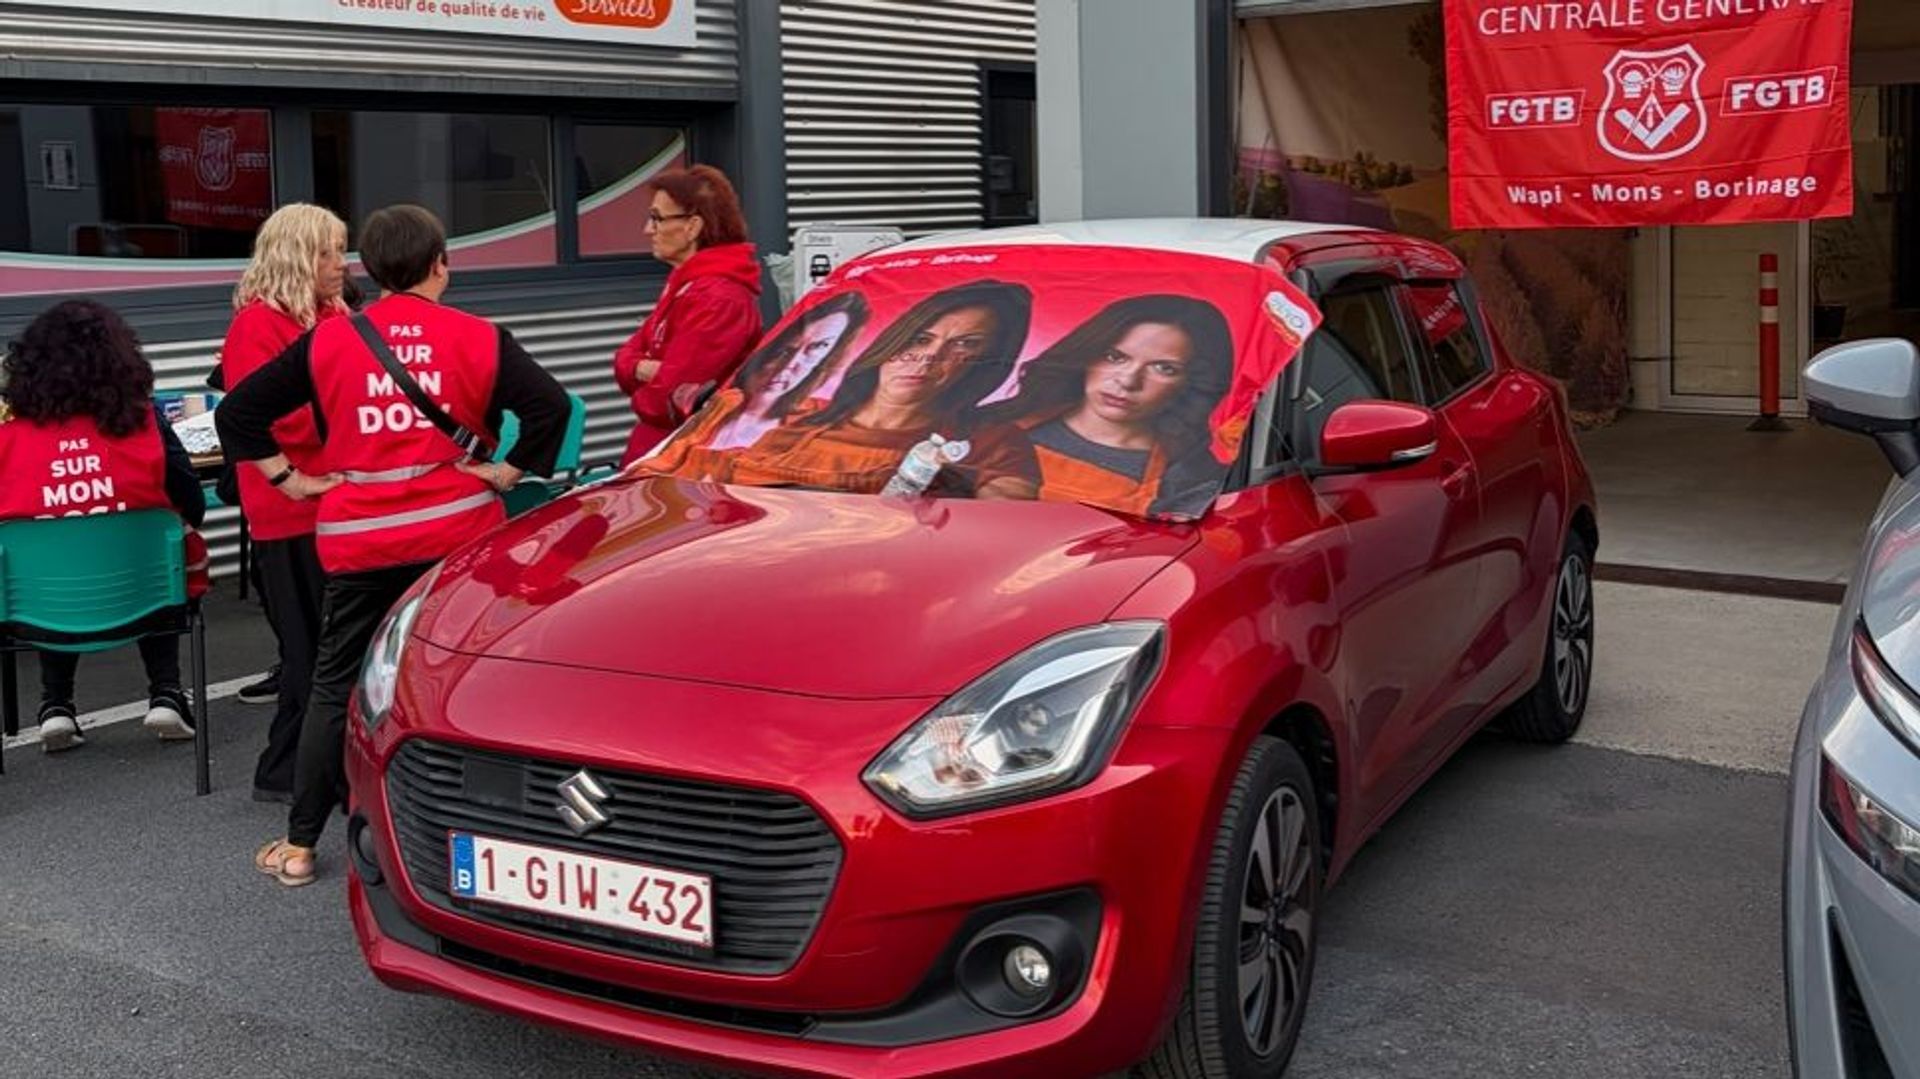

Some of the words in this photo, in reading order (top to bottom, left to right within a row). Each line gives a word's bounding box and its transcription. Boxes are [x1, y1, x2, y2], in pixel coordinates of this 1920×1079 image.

[416, 0, 437, 13] de
[441, 1, 498, 17] qualité
[501, 4, 520, 19] de
[523, 6, 546, 21] vie
[1478, 0, 1645, 35] CENTRALE
[1730, 75, 1826, 110] FGTB
[1490, 96, 1575, 125] FGTB
[1507, 184, 1562, 206] Wapi
[1591, 182, 1663, 202] Mons
[1695, 174, 1818, 200] Borinage
[389, 325, 423, 338] PAS
[389, 344, 433, 365] UR
[366, 371, 442, 398] MN
[59, 438, 89, 453] PAS
[51, 455, 102, 478] SUR
[42, 476, 115, 508] MON
[458, 868, 472, 890] B
[481, 848, 704, 933] 1-GIW-432
